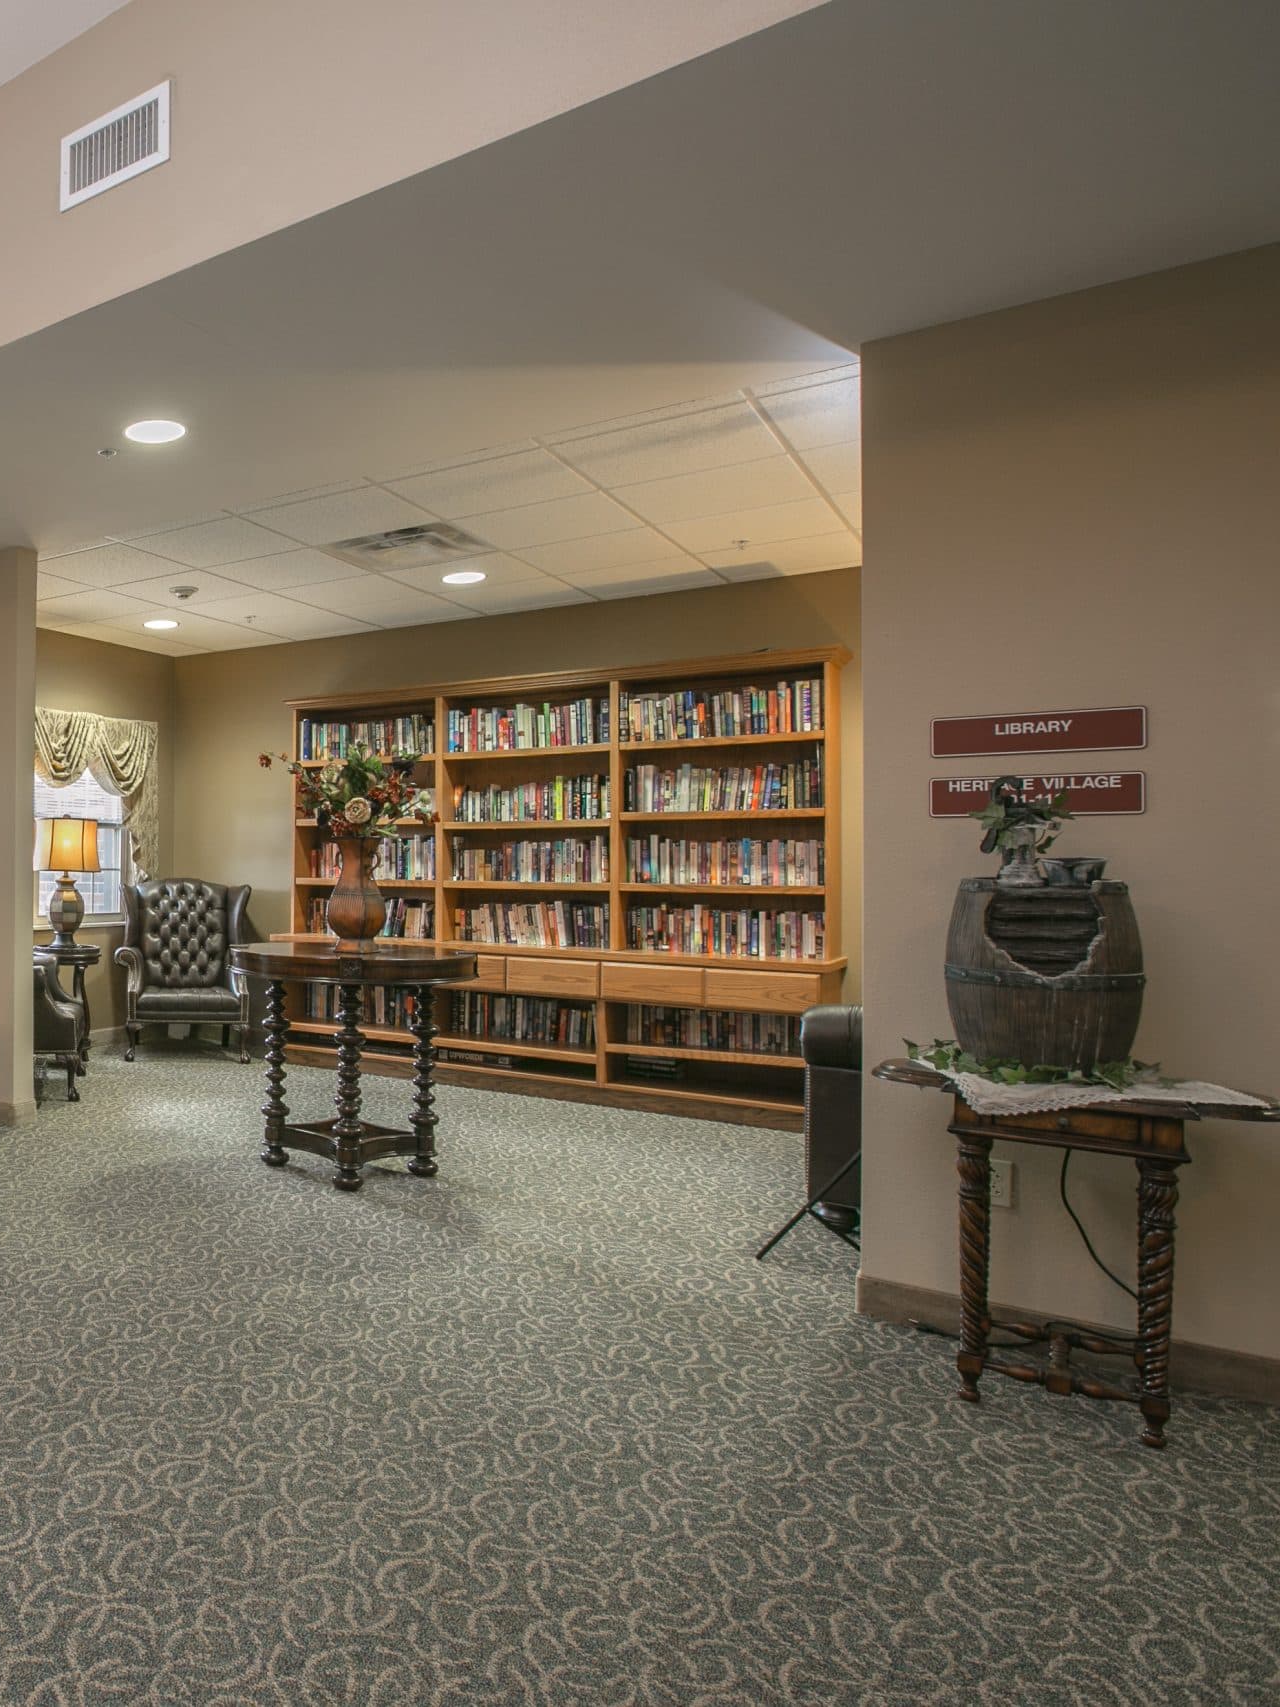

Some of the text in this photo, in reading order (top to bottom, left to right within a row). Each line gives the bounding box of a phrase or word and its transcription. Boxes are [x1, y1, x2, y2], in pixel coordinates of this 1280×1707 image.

[994, 719, 1072, 736] LIBRARY
[947, 775, 1122, 793] HERIAE VILLAGE
